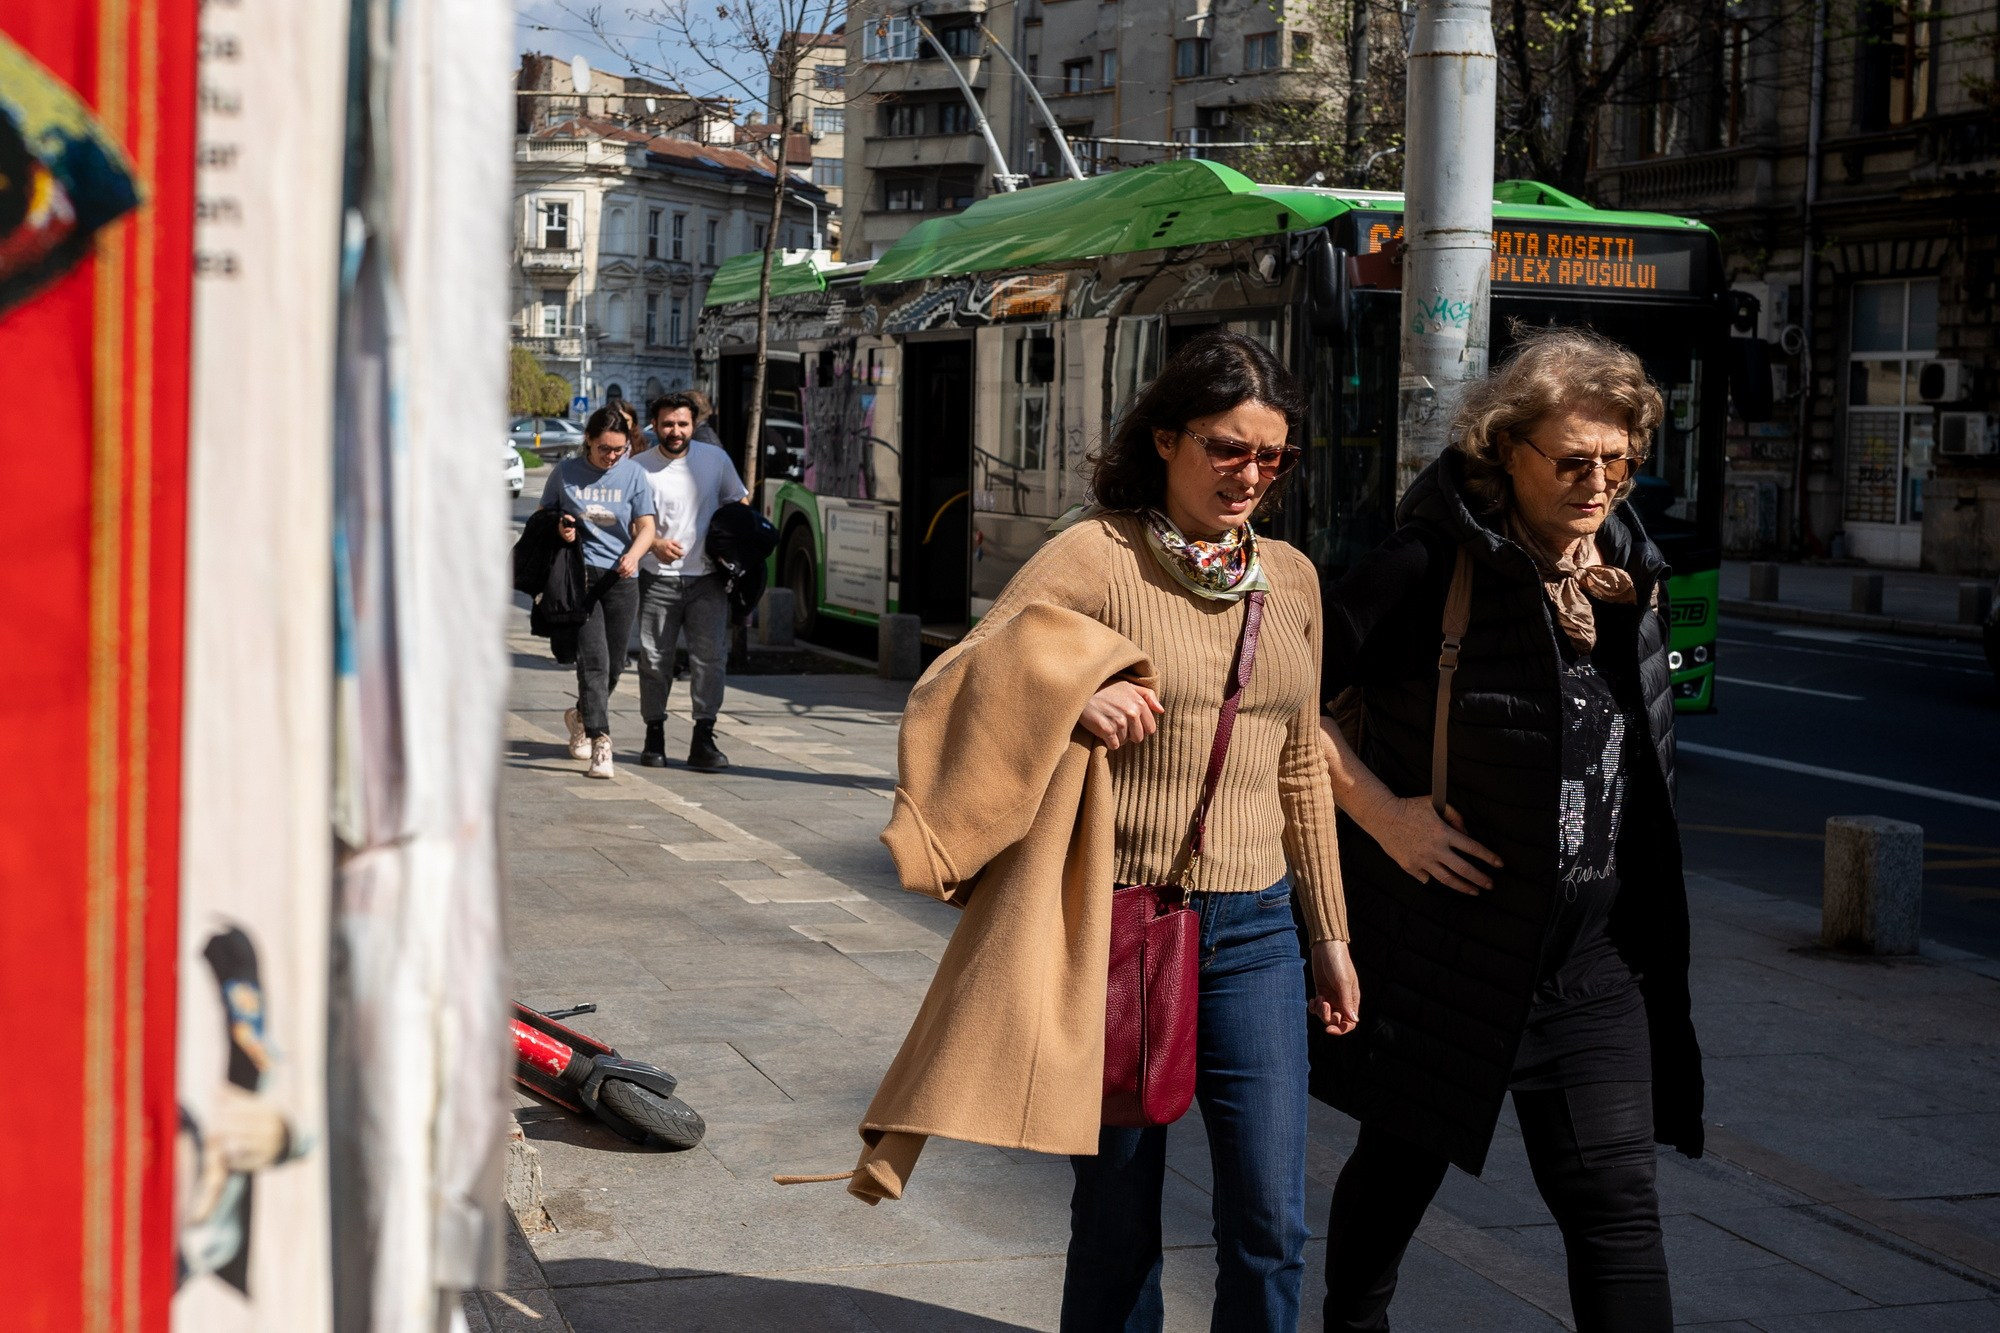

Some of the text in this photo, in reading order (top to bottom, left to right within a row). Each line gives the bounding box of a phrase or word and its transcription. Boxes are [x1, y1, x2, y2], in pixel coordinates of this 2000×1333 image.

[1547, 234, 1634, 262] ROSETTI
[1559, 260, 1656, 289] APUSULUI
[575, 486, 622, 503] AUSTIN
